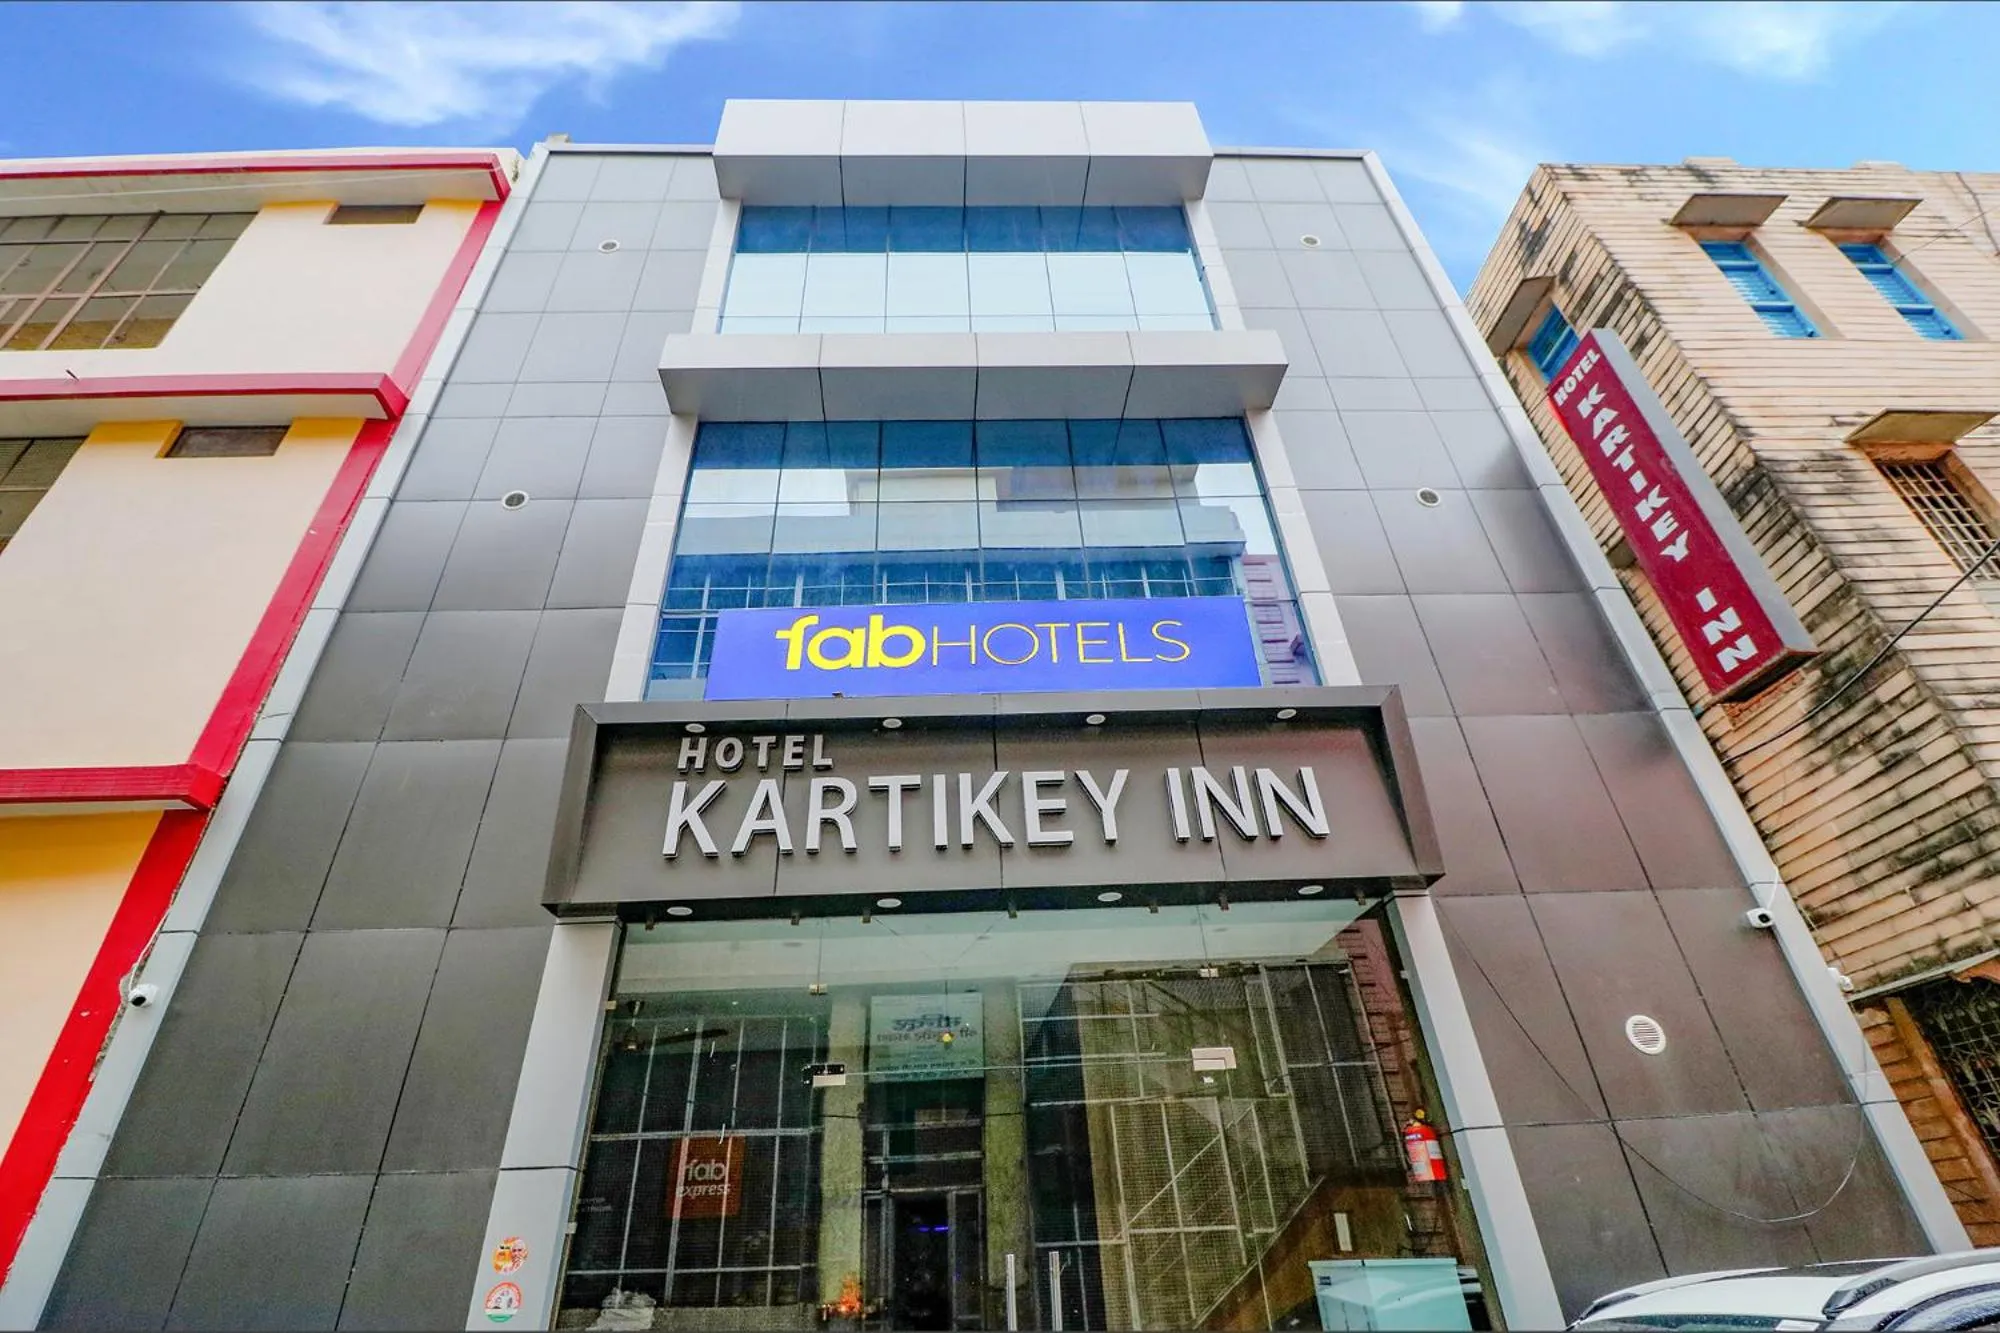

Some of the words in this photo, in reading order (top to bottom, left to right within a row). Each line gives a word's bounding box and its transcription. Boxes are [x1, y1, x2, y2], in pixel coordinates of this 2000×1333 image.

[1554, 349, 1600, 407] HOTEL
[1577, 382, 1691, 563] KARTIKEY
[1695, 587, 1758, 673] INN
[677, 734, 834, 773] HOTEL
[662, 768, 1130, 859] KARTIKEY
[1166, 765, 1330, 842] INN
[685, 1158, 727, 1181] fab
